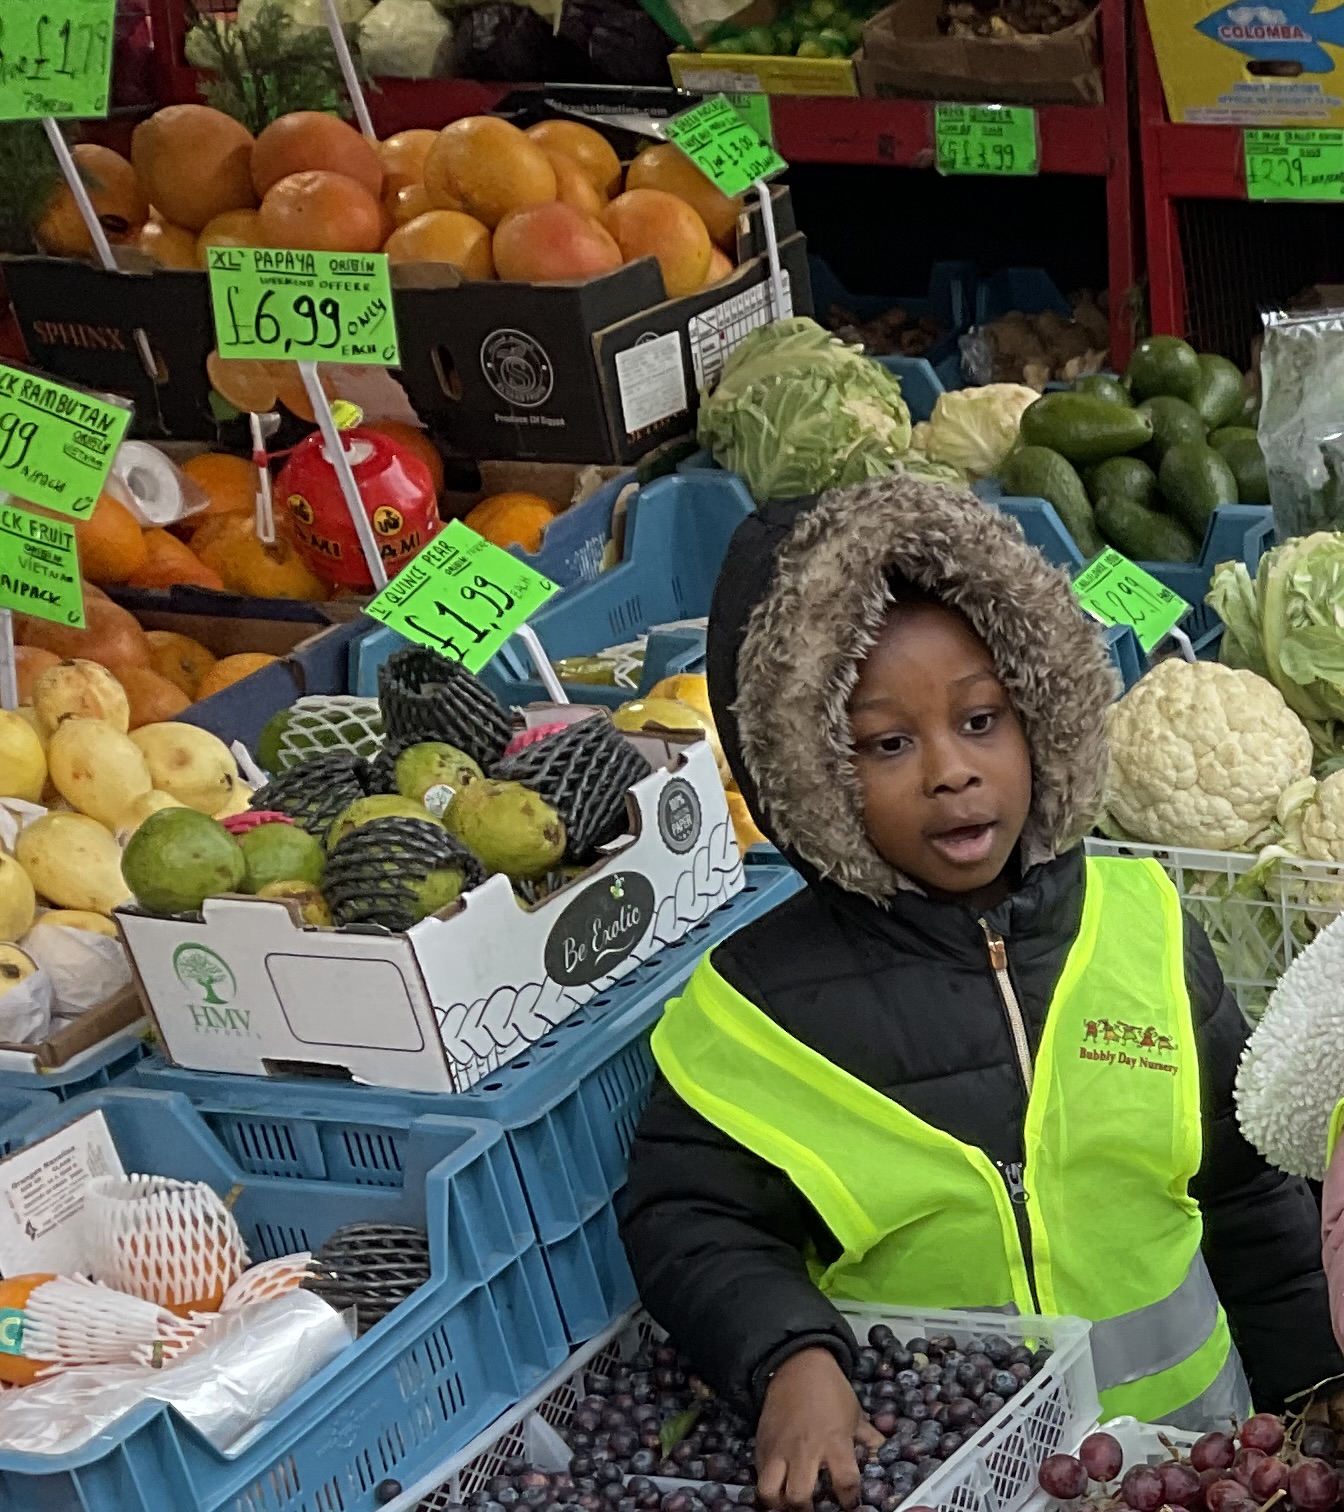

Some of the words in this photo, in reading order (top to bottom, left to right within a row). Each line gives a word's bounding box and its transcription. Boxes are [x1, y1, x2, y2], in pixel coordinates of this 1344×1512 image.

[1219, 26, 1305, 40] COLOMBA
[254, 250, 316, 272] PAPAYA
[329, 257, 375, 273] ORIGIN
[347, 298, 387, 337] ONLY
[341, 345, 377, 356] EACH
[20, 379, 116, 432] RAMBUTAN
[29, 518, 74, 549] FRUIT
[17, 555, 74, 584] VIETNAM
[384, 565, 428, 605] QUINCE
[421, 539, 456, 568] PEAR
[562, 937, 588, 973] Be
[592, 904, 640, 953] Exotic
[187, 1004, 251, 1031] HMV
[1079, 1046, 1117, 1066] Bubbly
[1118, 1051, 1137, 1070] Day
[1139, 1056, 1179, 1077] Nursery
